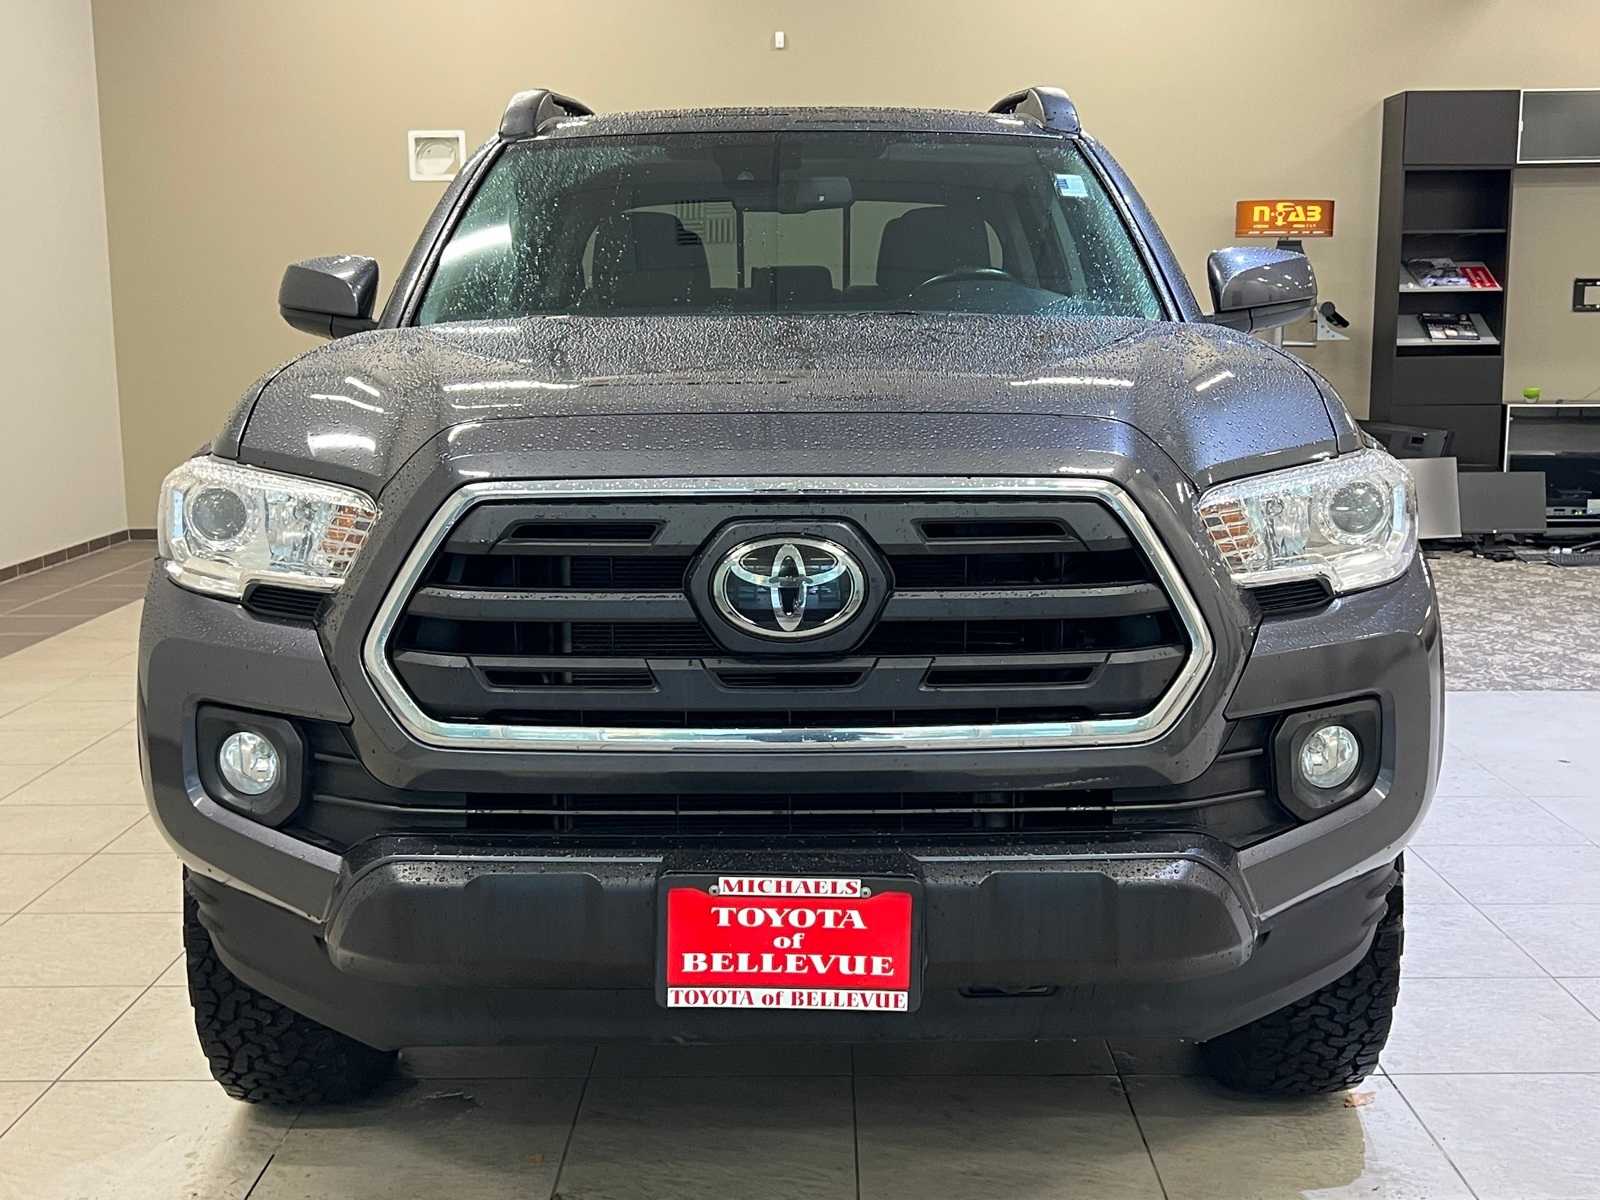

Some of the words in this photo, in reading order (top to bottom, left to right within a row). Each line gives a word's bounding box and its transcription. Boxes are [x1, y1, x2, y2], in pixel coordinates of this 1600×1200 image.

[722, 879, 859, 896] MICHAELS
[710, 907, 868, 930] TOYOTA
[772, 932, 805, 949] of
[681, 952, 895, 977] BELLEVUE
[669, 989, 754, 1006] TOYOTA
[761, 991, 784, 1007] of
[790, 991, 907, 1009] BELLEVUE
